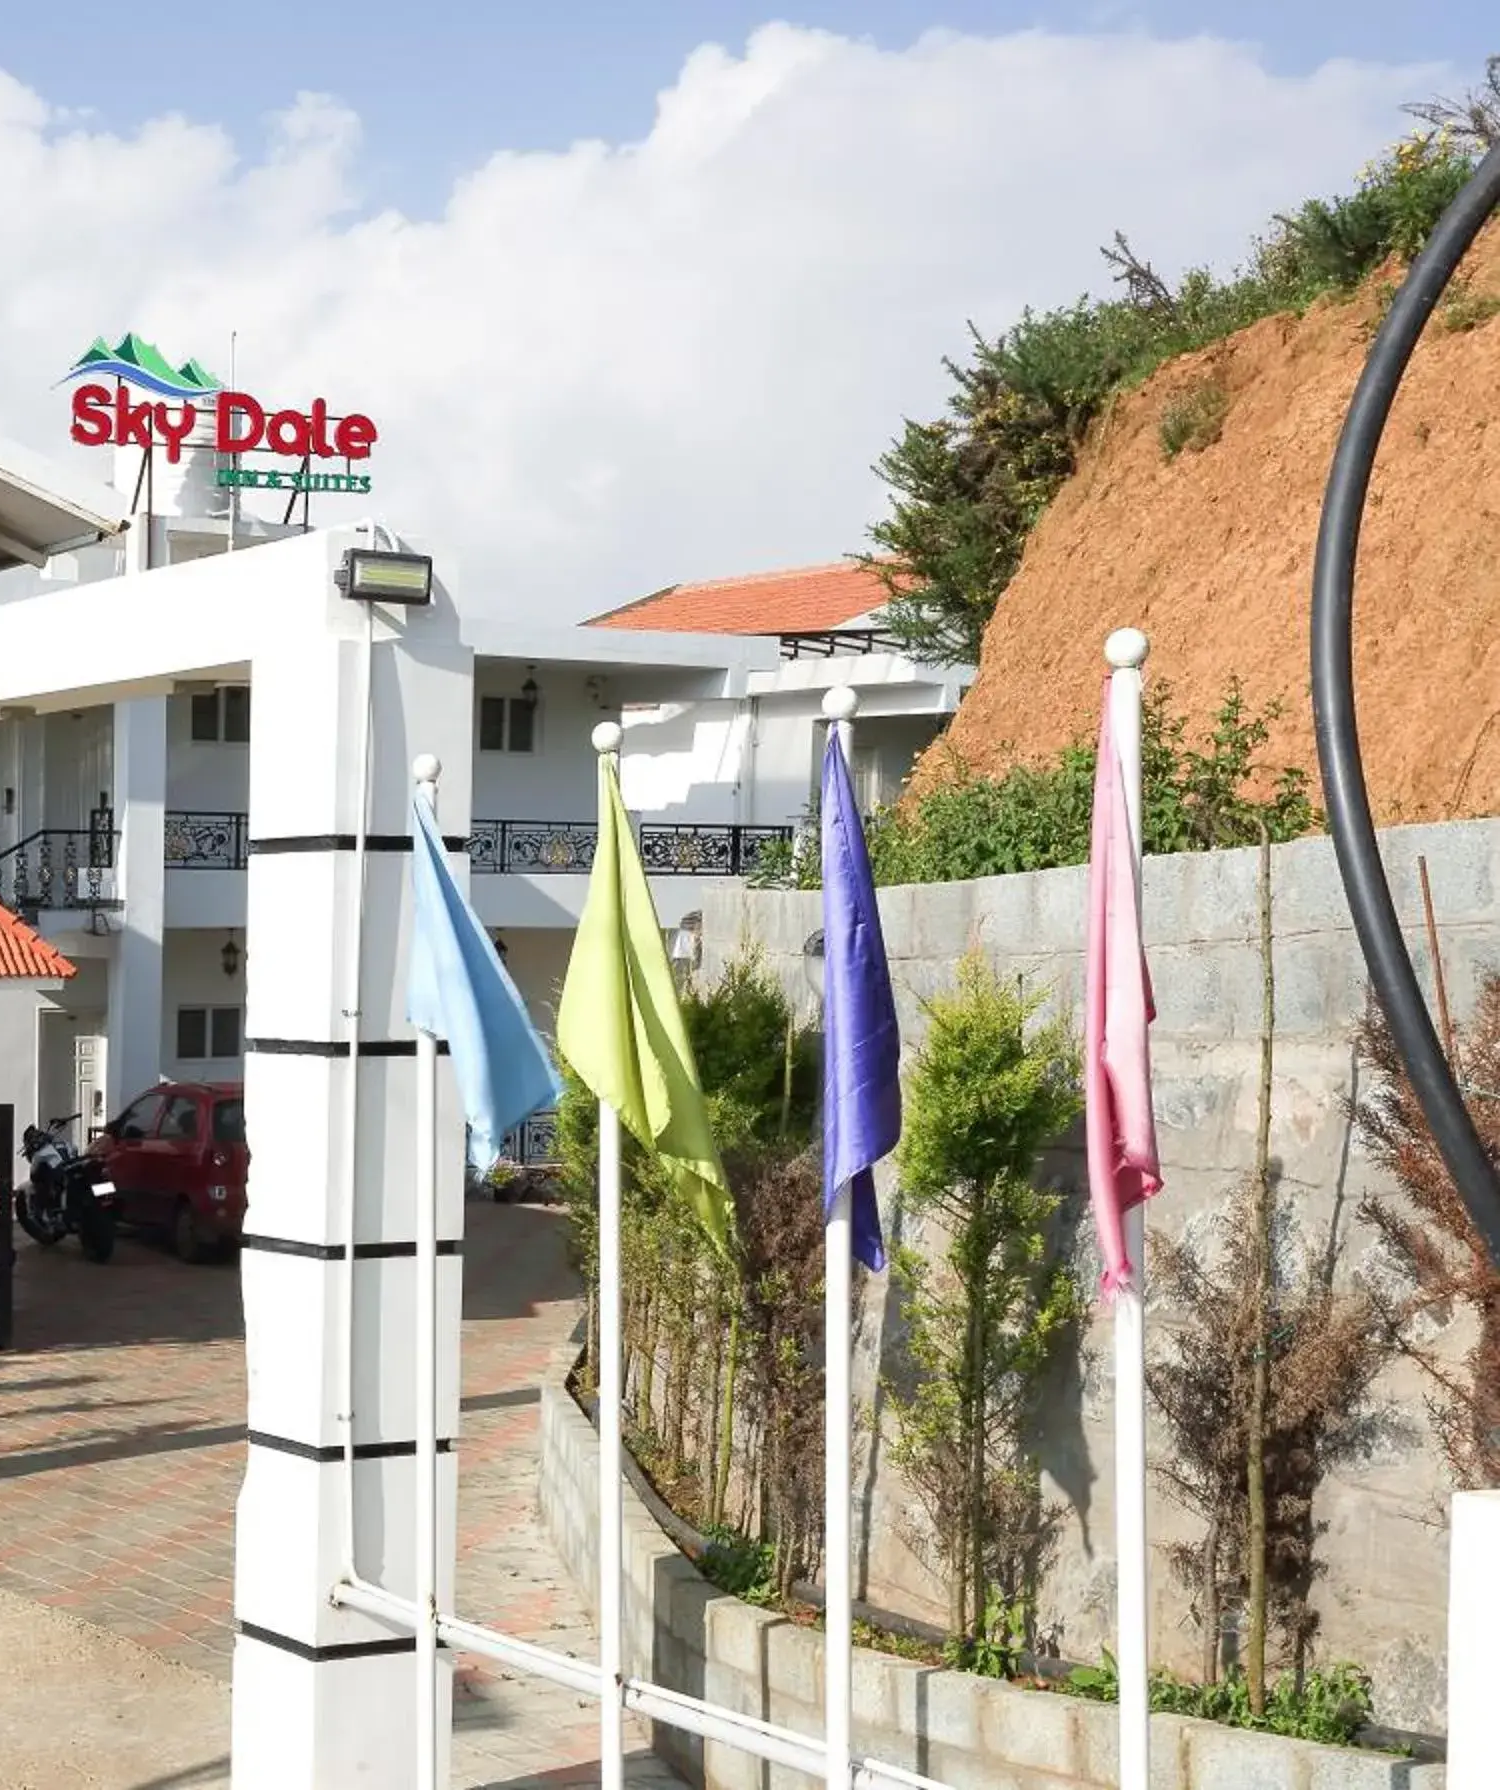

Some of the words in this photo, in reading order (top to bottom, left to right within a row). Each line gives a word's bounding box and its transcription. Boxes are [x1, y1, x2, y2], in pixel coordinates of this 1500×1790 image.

[70, 384, 196, 464] Sky
[215, 391, 377, 460] Dale
[266, 470, 283, 489] &
[292, 471, 372, 493] SUITES
